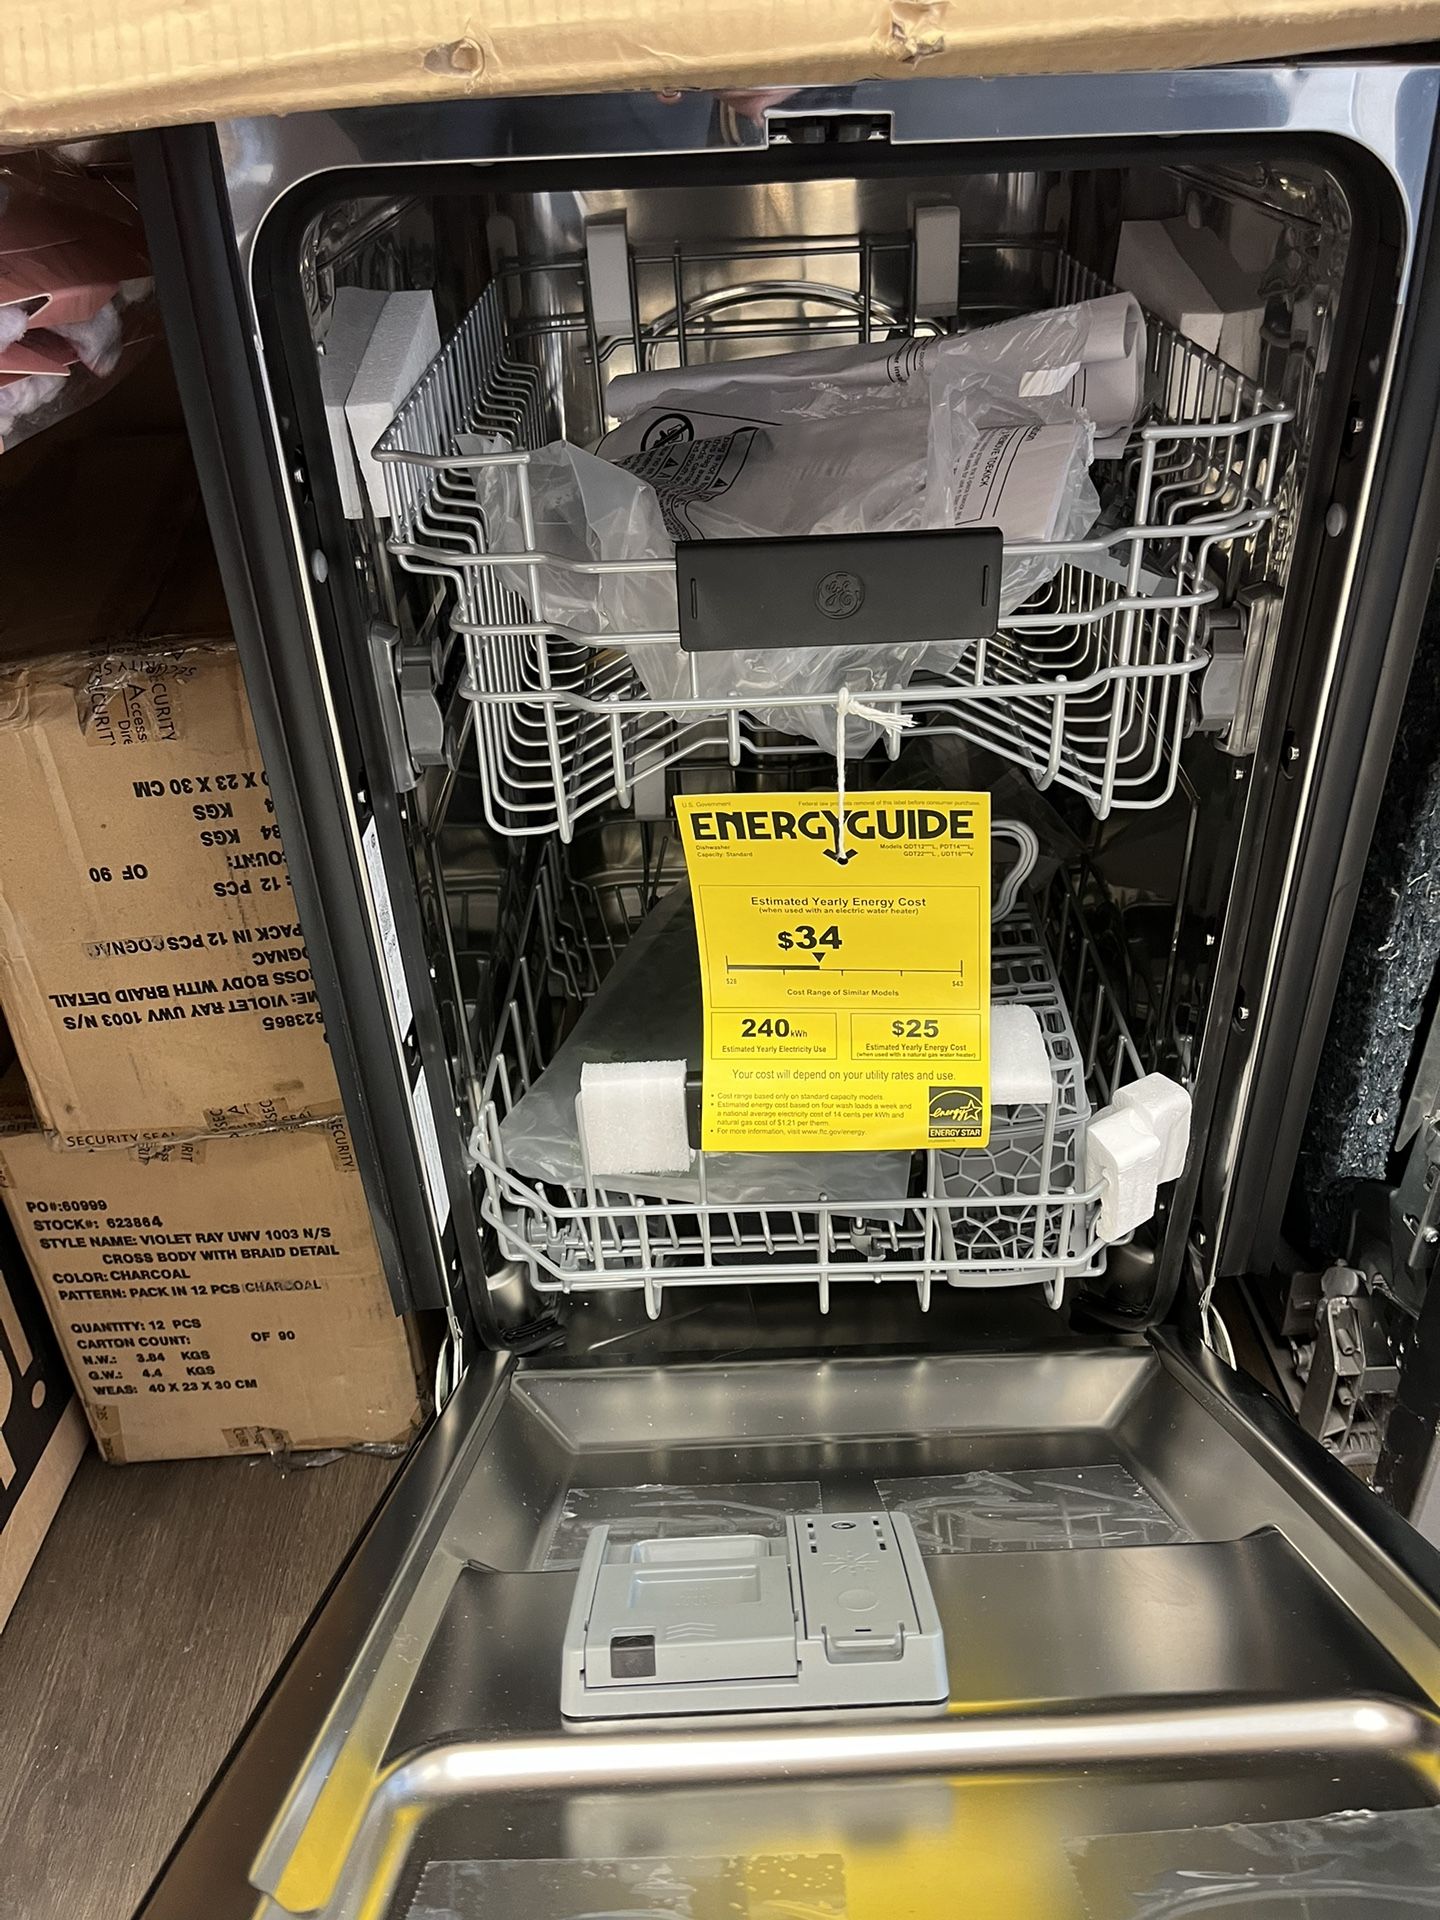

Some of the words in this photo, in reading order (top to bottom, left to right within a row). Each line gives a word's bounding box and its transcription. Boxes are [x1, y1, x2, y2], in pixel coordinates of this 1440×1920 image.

[151, 683, 177, 741] CURITY
[169, 777, 193, 795] 30
[195, 775, 211, 792] X
[214, 773, 238, 790] 23
[241, 771, 257, 788] X
[132, 780, 165, 797] CM
[192, 802, 233, 820] KGS
[690, 809, 973, 840] ENERGYGUIDE
[199, 828, 240, 846] KGS
[88, 866, 112, 883] 90
[121, 863, 148, 880] OF
[213, 879, 255, 897] PCS
[259, 876, 281, 893] 12
[750, 896, 808, 908] Estimated
[810, 896, 851, 908] Yearly
[852, 896, 894, 908] Energy
[897, 897, 926, 906] Cost
[206, 931, 228, 946] 12
[231, 928, 252, 943] IN
[254, 923, 302, 941] PACK
[777, 925, 842, 952] $34
[166, 933, 206, 950] PCS
[221, 974, 269, 991] BODY
[272, 968, 313, 985] OSS
[114, 984, 170, 1002] BRAID
[171, 979, 218, 997] WITH
[786, 988, 805, 997] Cost
[806, 988, 831, 996] Range
[48, 989, 111, 1007] DETAIL
[228, 994, 288, 1012] VIOLET
[147, 1005, 186, 1022] UWV
[190, 1001, 224, 1017] RAY
[62, 1013, 98, 1029] N/S
[100, 1010, 142, 1026] 1003
[262, 1010, 324, 1030] 623865
[741, 1018, 789, 1037] 240
[790, 1029, 807, 1037] kWh
[891, 1019, 938, 1037] $25
[756, 1045, 777, 1053] Yearly
[900, 1043, 922, 1051] Yearly
[923, 1043, 948, 1052] Energy
[949, 1043, 966, 1051] Cost
[732, 1068, 753, 1079] Your
[755, 1070, 774, 1079] cost
[776, 1069, 790, 1078] will
[792, 1069, 826, 1079] depend
[828, 1071, 841, 1079] on
[842, 1071, 863, 1081] your
[865, 1069, 889, 1081] utility
[891, 1071, 914, 1080] rates
[916, 1070, 933, 1080] and
[936, 1072, 955, 1080] use.
[66, 1133, 139, 1147] SECURITY
[930, 1128, 960, 1137] ENERGY
[961, 1128, 981, 1137] STAR
[32, 1218, 99, 1231] STOCK#:
[105, 1215, 163, 1228] 623864
[39, 1236, 87, 1249] STYLE
[88, 1235, 138, 1247] NAME:
[138, 1232, 192, 1245] VIOLET
[194, 1231, 223, 1243] RAY
[226, 1229, 263, 1242] UWV
[262, 1226, 302, 1242] 1003
[301, 1226, 331, 1241] N/S
[101, 1252, 154, 1264] CROSS
[155, 1250, 196, 1262] BODY
[199, 1248, 237, 1261] WITH
[239, 1245, 288, 1261] BRAID
[289, 1243, 340, 1259] DETAIL
[51, 1271, 109, 1284] COLOR:
[109, 1268, 191, 1281] CHARCOAL
[57, 1287, 127, 1300] PATTERN:
[128, 1286, 170, 1298] PACK
[170, 1284, 189, 1296] IN
[188, 1281, 208, 1296] 12
[209, 1280, 240, 1297] PCS
[70, 1320, 145, 1334] QUANTITY:
[148, 1319, 165, 1330] 12
[171, 1318, 201, 1329] PCS
[76, 1337, 135, 1349] CARTON
[137, 1335, 190, 1348] COUNT:
[249, 1330, 274, 1344] OF
[278, 1329, 295, 1340] 90
[135, 1351, 165, 1363] 3.84
[179, 1349, 210, 1360] KGS
[142, 1368, 162, 1377] 4.4
[185, 1365, 215, 1376] KGS
[148, 1383, 165, 1393] 40
[167, 1382, 179, 1392] X
[181, 1381, 198, 1391] 23
[200, 1380, 212, 1390] X
[213, 1379, 231, 1390] 30
[234, 1378, 258, 1389] CM
